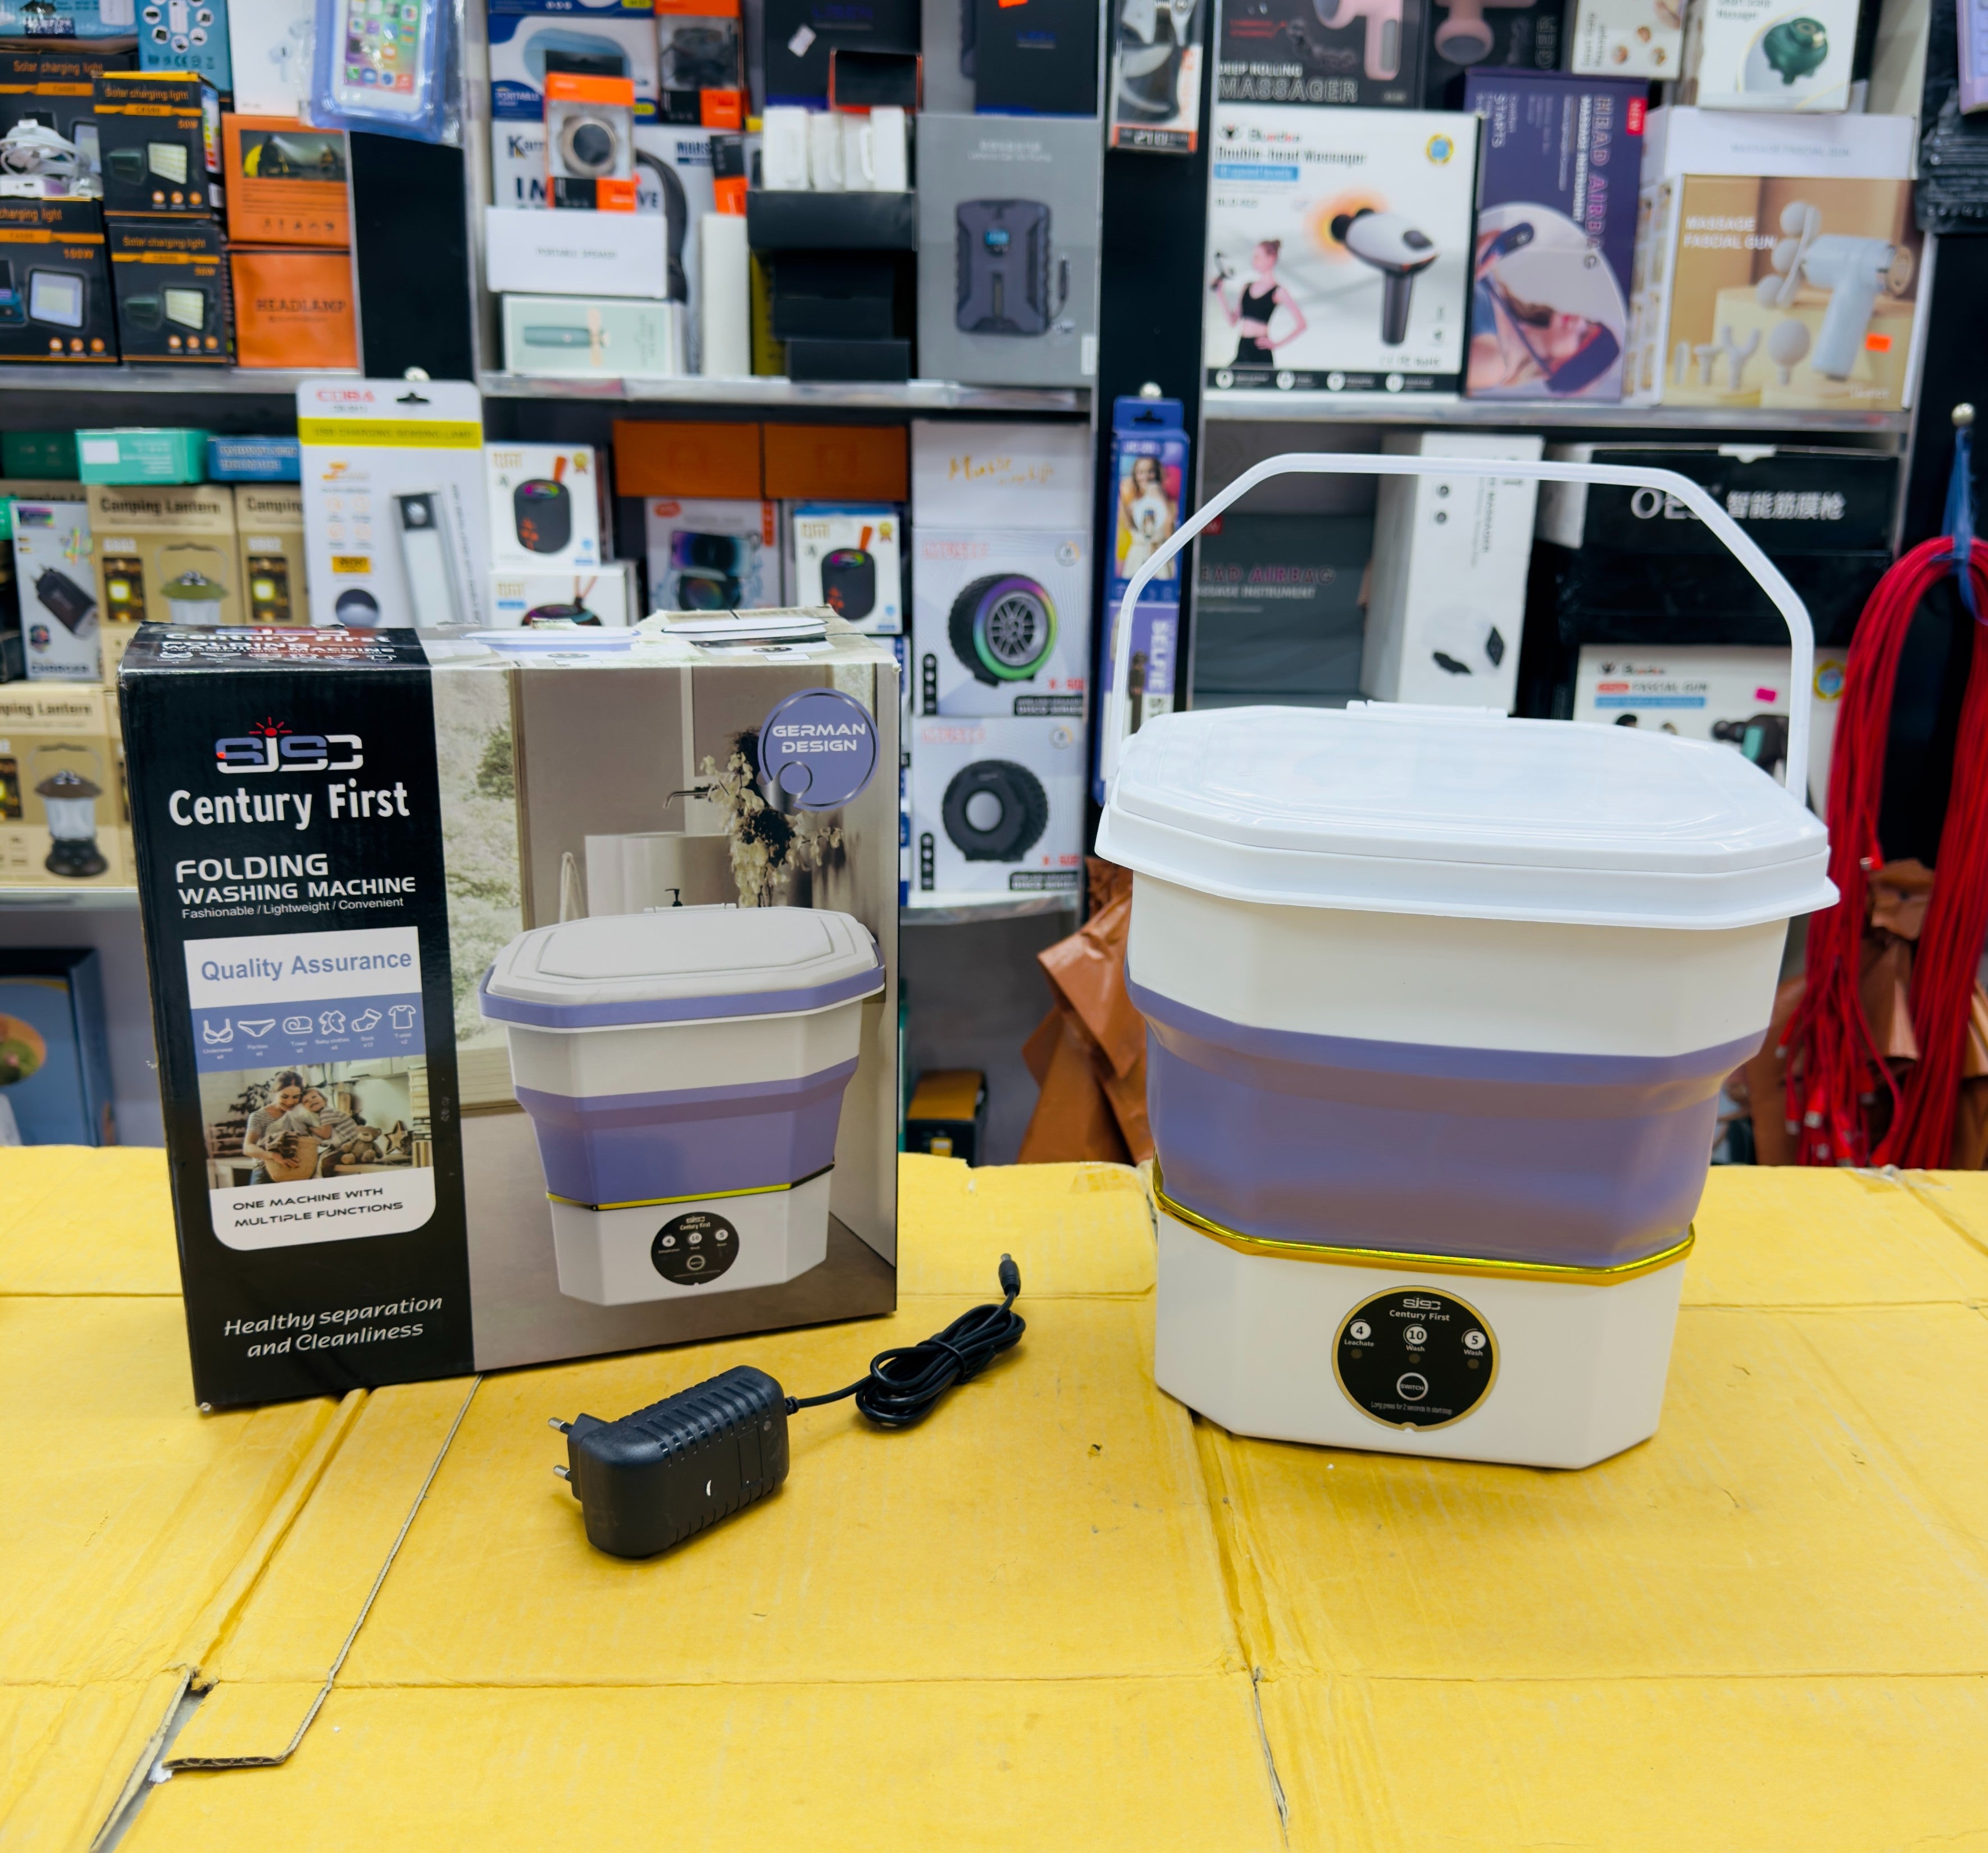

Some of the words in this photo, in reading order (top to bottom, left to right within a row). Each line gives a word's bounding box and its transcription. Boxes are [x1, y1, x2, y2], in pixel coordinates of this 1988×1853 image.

[13, 60, 37, 72] Solar
[40, 61, 80, 75] charging
[1249, 62, 1303, 78] ROLLING
[104, 88, 128, 98] Solar
[130, 90, 167, 101] charging
[169, 91, 189, 102] light
[1219, 77, 1358, 102] MASSAGER
[1627, 100, 1644, 131] NEW
[1591, 95, 1613, 165] HEAD
[41, 207, 62, 222] light
[1584, 173, 1609, 269] AIRBAG
[1686, 216, 1755, 231] MASSAGE
[122, 235, 143, 247] Solar
[147, 238, 184, 249] charging
[186, 239, 206, 249] light
[1684, 234, 1741, 249] FASCIAL
[1744, 235, 1776, 250] GUN
[256, 299, 347, 315] HEADLAMP
[101, 497, 162, 515] Camping
[167, 498, 221, 514] Lantern
[1726, 490, 1847, 521] 智能筋膜枪
[1202, 566, 1241, 583] EAD
[1248, 566, 1336, 585] AIRBAG
[165, 632, 299, 642] Century
[316, 635, 391, 643] First
[1149, 619, 1168, 690] SELFIE
[38, 701, 92, 716] Lantern
[772, 723, 866, 737] GERMAN
[781, 739, 857, 754] DESIGN
[169, 787, 312, 830] Century
[327, 778, 411, 819] First
[175, 853, 329, 884] FOLDING
[178, 882, 298, 905] WASHING
[308, 876, 416, 898] MACHINE
[181, 904, 255, 919] Fashionable
[263, 900, 330, 916] Lightweight
[339, 897, 404, 910] Convenient
[201, 957, 283, 981] Quality
[291, 953, 412, 976] Assurance
[232, 1200, 265, 1212] ONE
[269, 1192, 342, 1208] MACHINE
[344, 1187, 384, 1200] WITH
[234, 1210, 313, 1228] MULTIPLE
[316, 1201, 404, 1220] FUNCTIONS
[224, 1312, 315, 1337] Healthy
[319, 1297, 443, 1326] separation
[1389, 1309, 1426, 1321] Century
[1429, 1312, 1450, 1322] First
[1355, 1326, 1364, 1335] 4
[1408, 1330, 1424, 1340] 10
[247, 1337, 291, 1359] and
[295, 1322, 424, 1351] Cleanliness
[1344, 1338, 1375, 1347] Leachate
[1471, 1335, 1479, 1345] 5
[1405, 1344, 1425, 1353] Wash
[1463, 1349, 1484, 1357] Wash
[1399, 1382, 1425, 1391] SWITCH
[1371, 1401, 1382, 1410] Long
